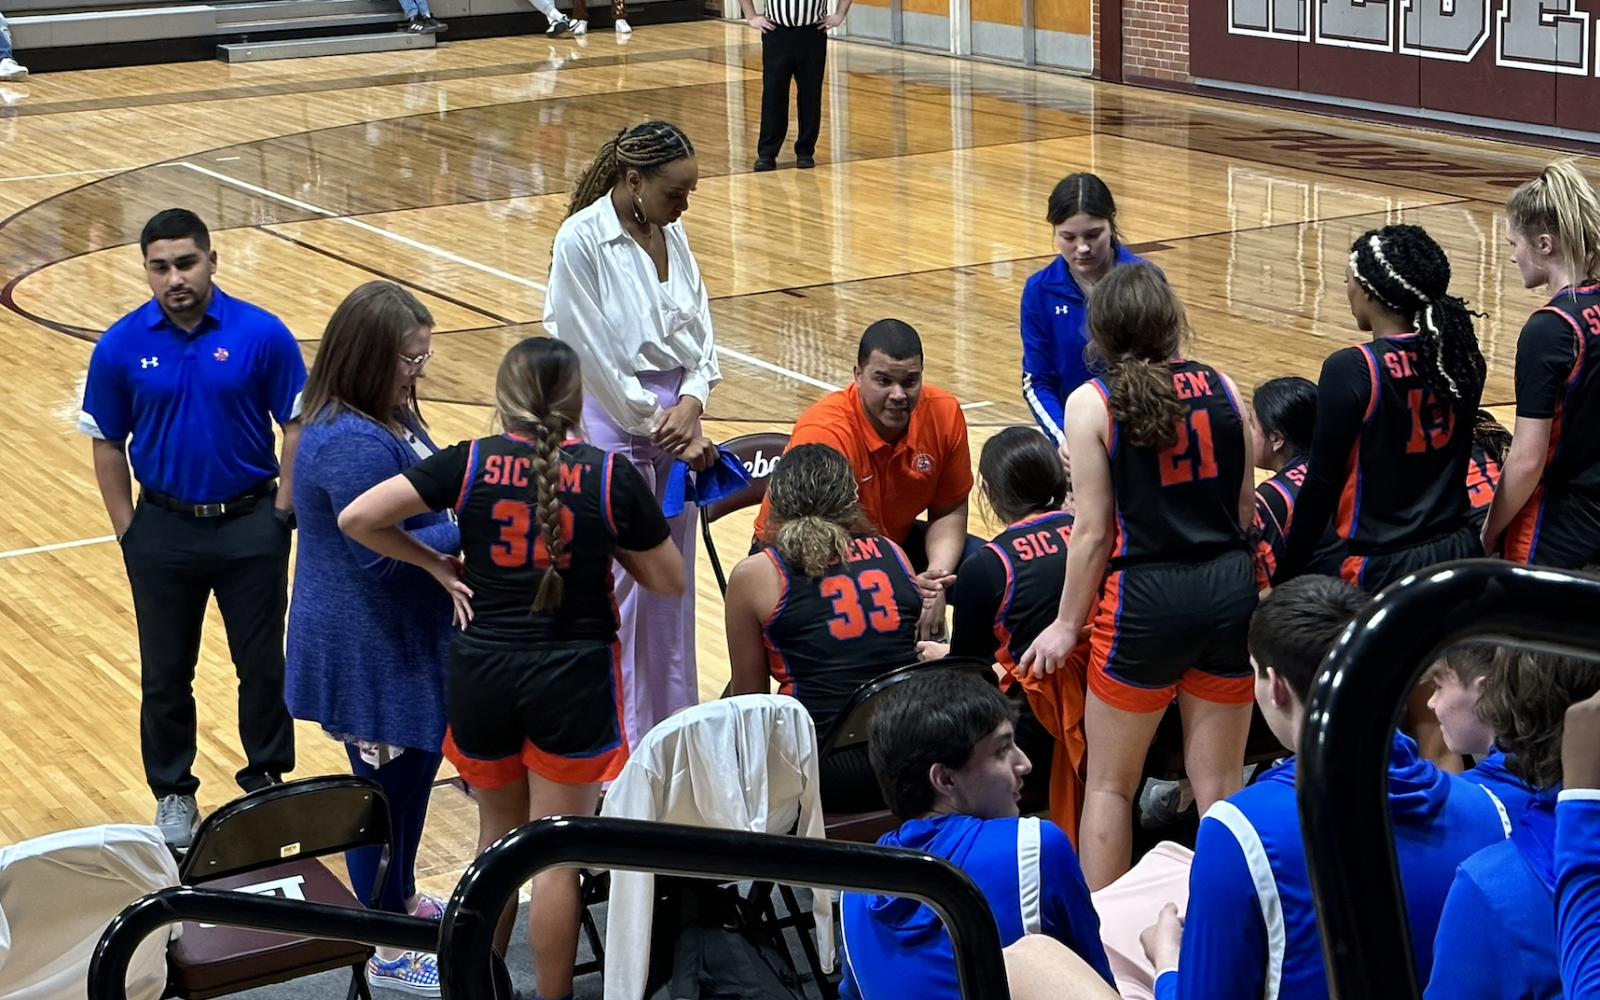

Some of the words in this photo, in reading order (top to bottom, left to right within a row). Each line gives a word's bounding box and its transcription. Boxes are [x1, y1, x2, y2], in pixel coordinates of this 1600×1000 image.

[484, 455, 530, 487] SIC
[1159, 408, 1219, 486] 21
[1012, 530, 1058, 560] SIC
[819, 569, 900, 640] 33
